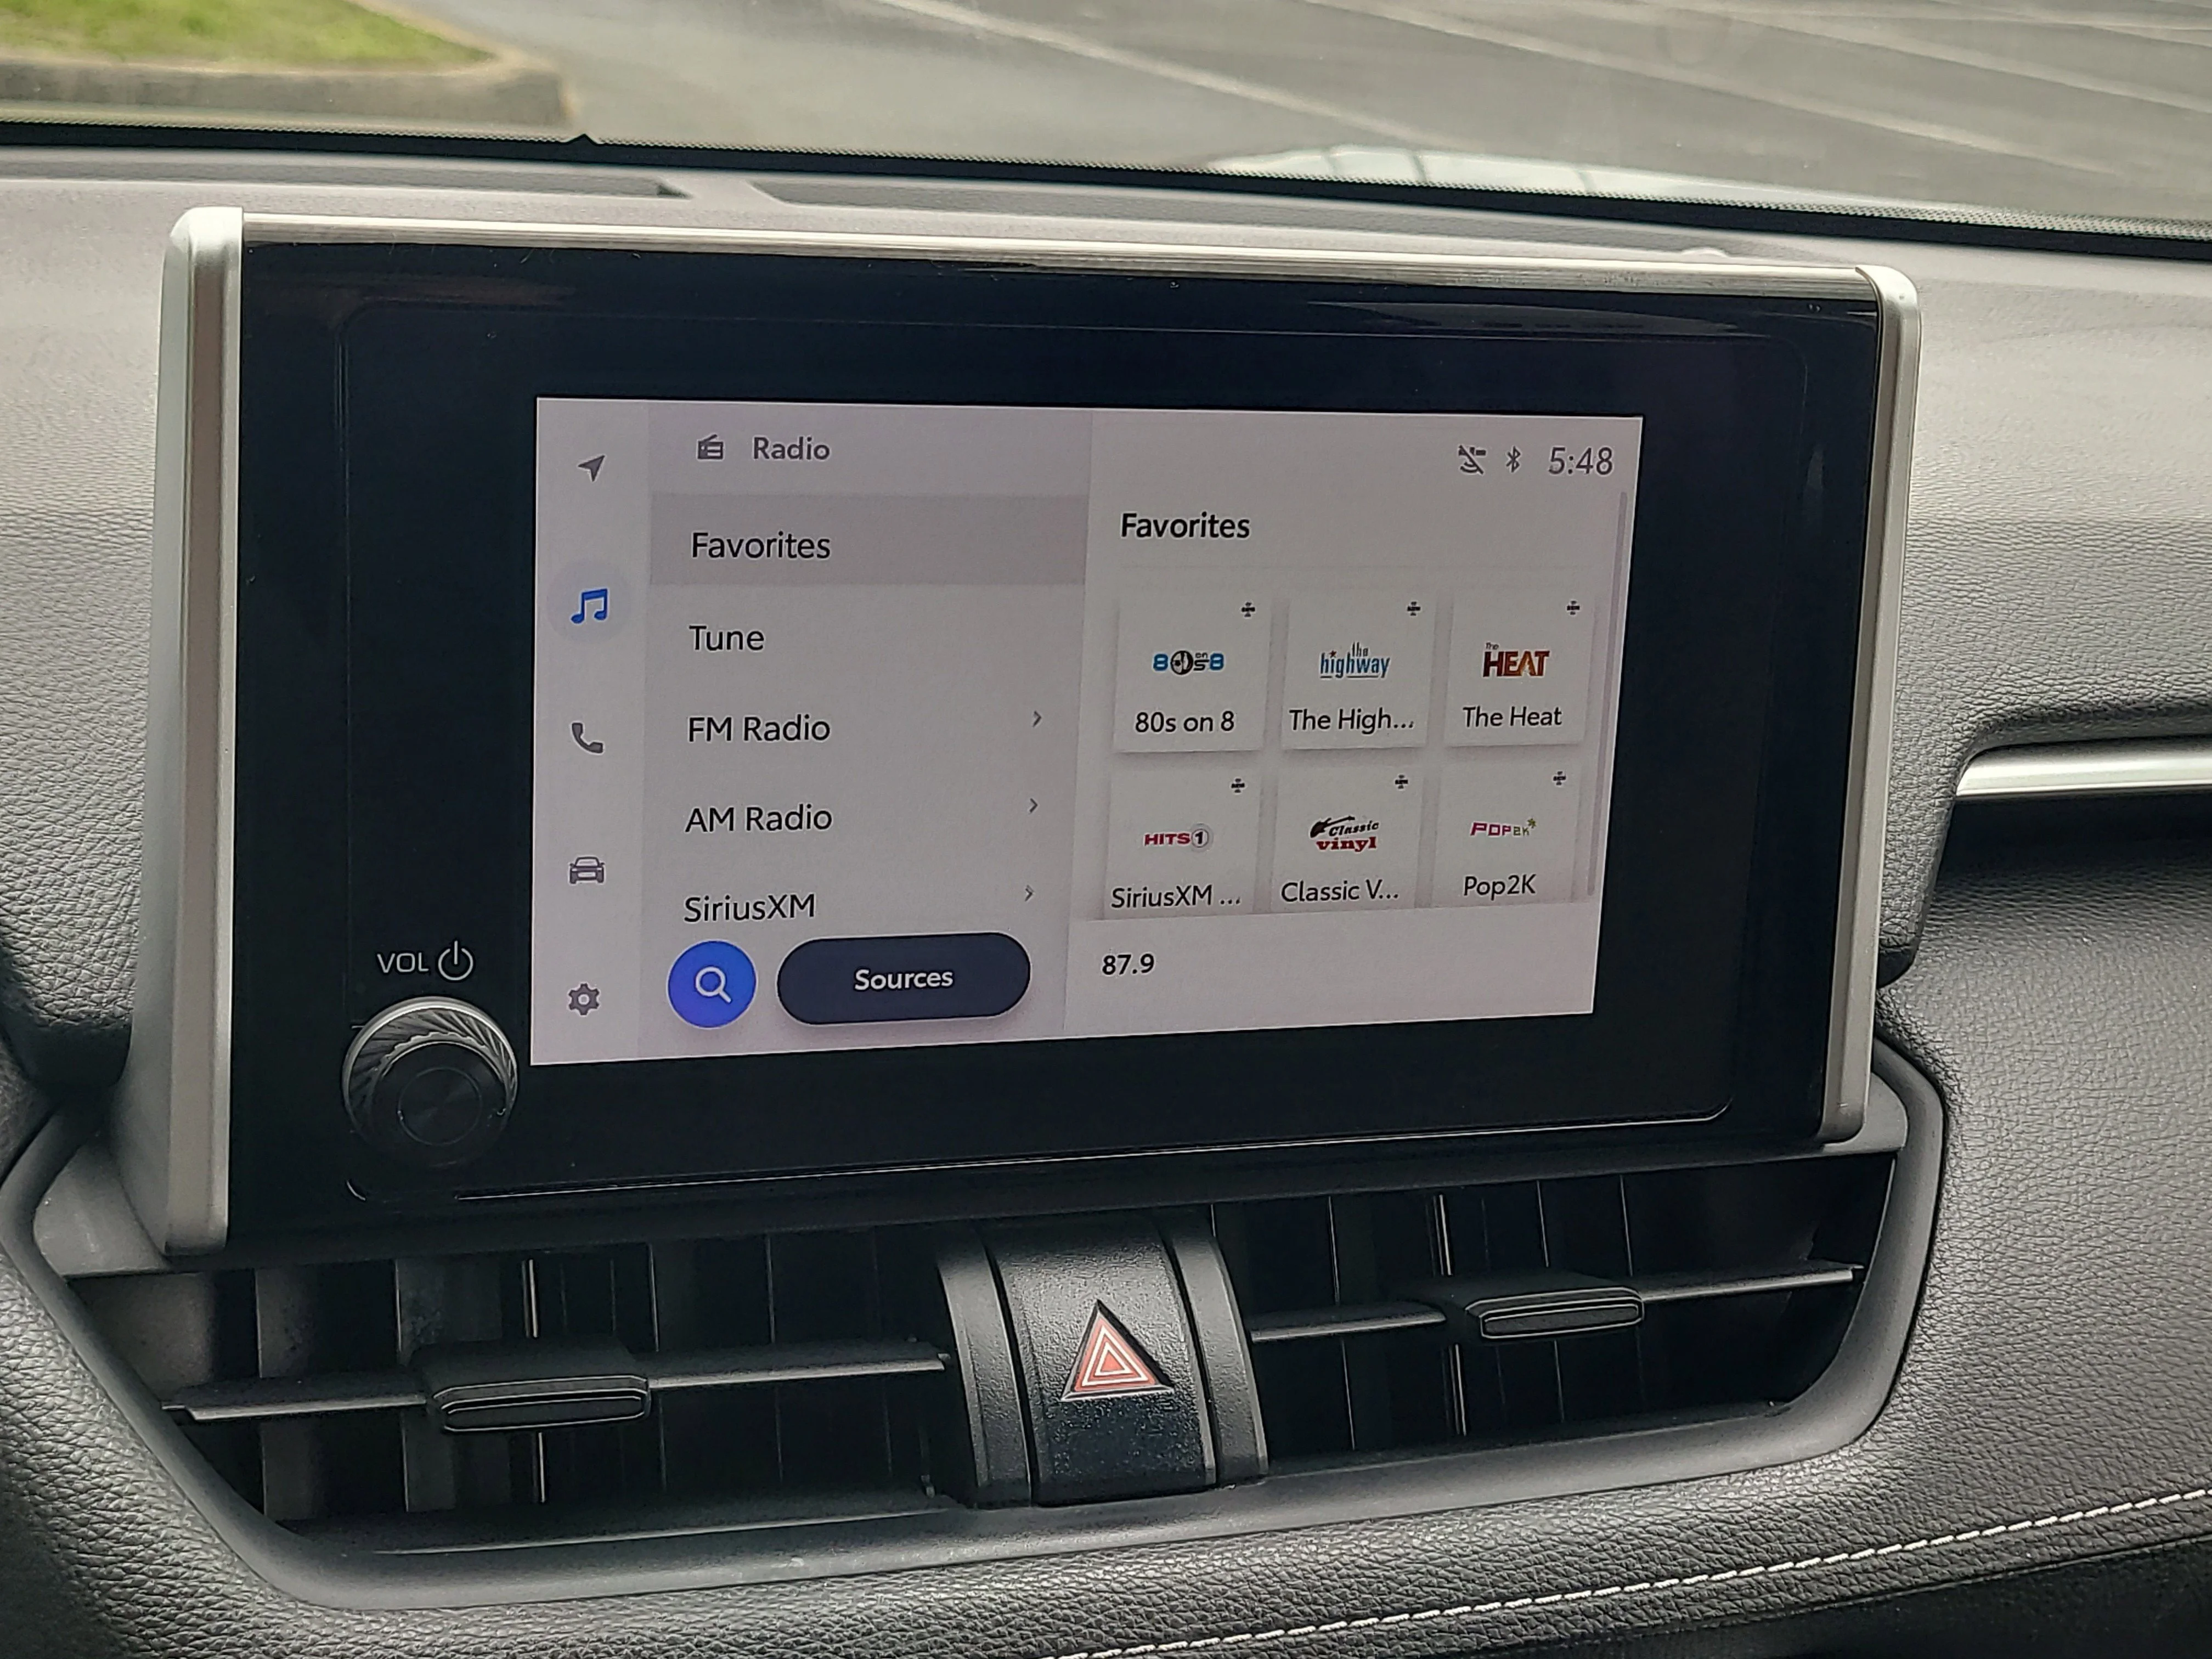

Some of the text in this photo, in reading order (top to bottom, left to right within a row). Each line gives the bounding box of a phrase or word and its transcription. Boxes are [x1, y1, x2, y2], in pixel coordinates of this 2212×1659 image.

[754, 436, 830, 460] Radio
[1548, 446, 1613, 475] 5:48
[1121, 511, 1250, 538] Favorites
[692, 531, 831, 559] Favorites
[689, 625, 765, 651] Tune
[1320, 650, 1391, 679] highway
[1483, 651, 1550, 677] HEAT
[689, 713, 831, 743] FM Radio
[1135, 710, 1235, 733] 80s on 8
[1289, 708, 1331, 731] The
[1463, 706, 1562, 727] The Heat
[685, 803, 833, 833] AM Radio
[1329, 820, 1379, 837] Classic
[1144, 833, 1191, 846] HITS
[1316, 836, 1377, 853] vinyl
[1111, 884, 1212, 909] SiriusXM
[1280, 880, 1360, 902] Classic
[1463, 873, 1536, 901] Pop2K
[684, 894, 815, 923] SiriusXM
[376, 952, 429, 974] VOL
[1102, 953, 1155, 976] 87.9
[854, 969, 953, 991] Sources
